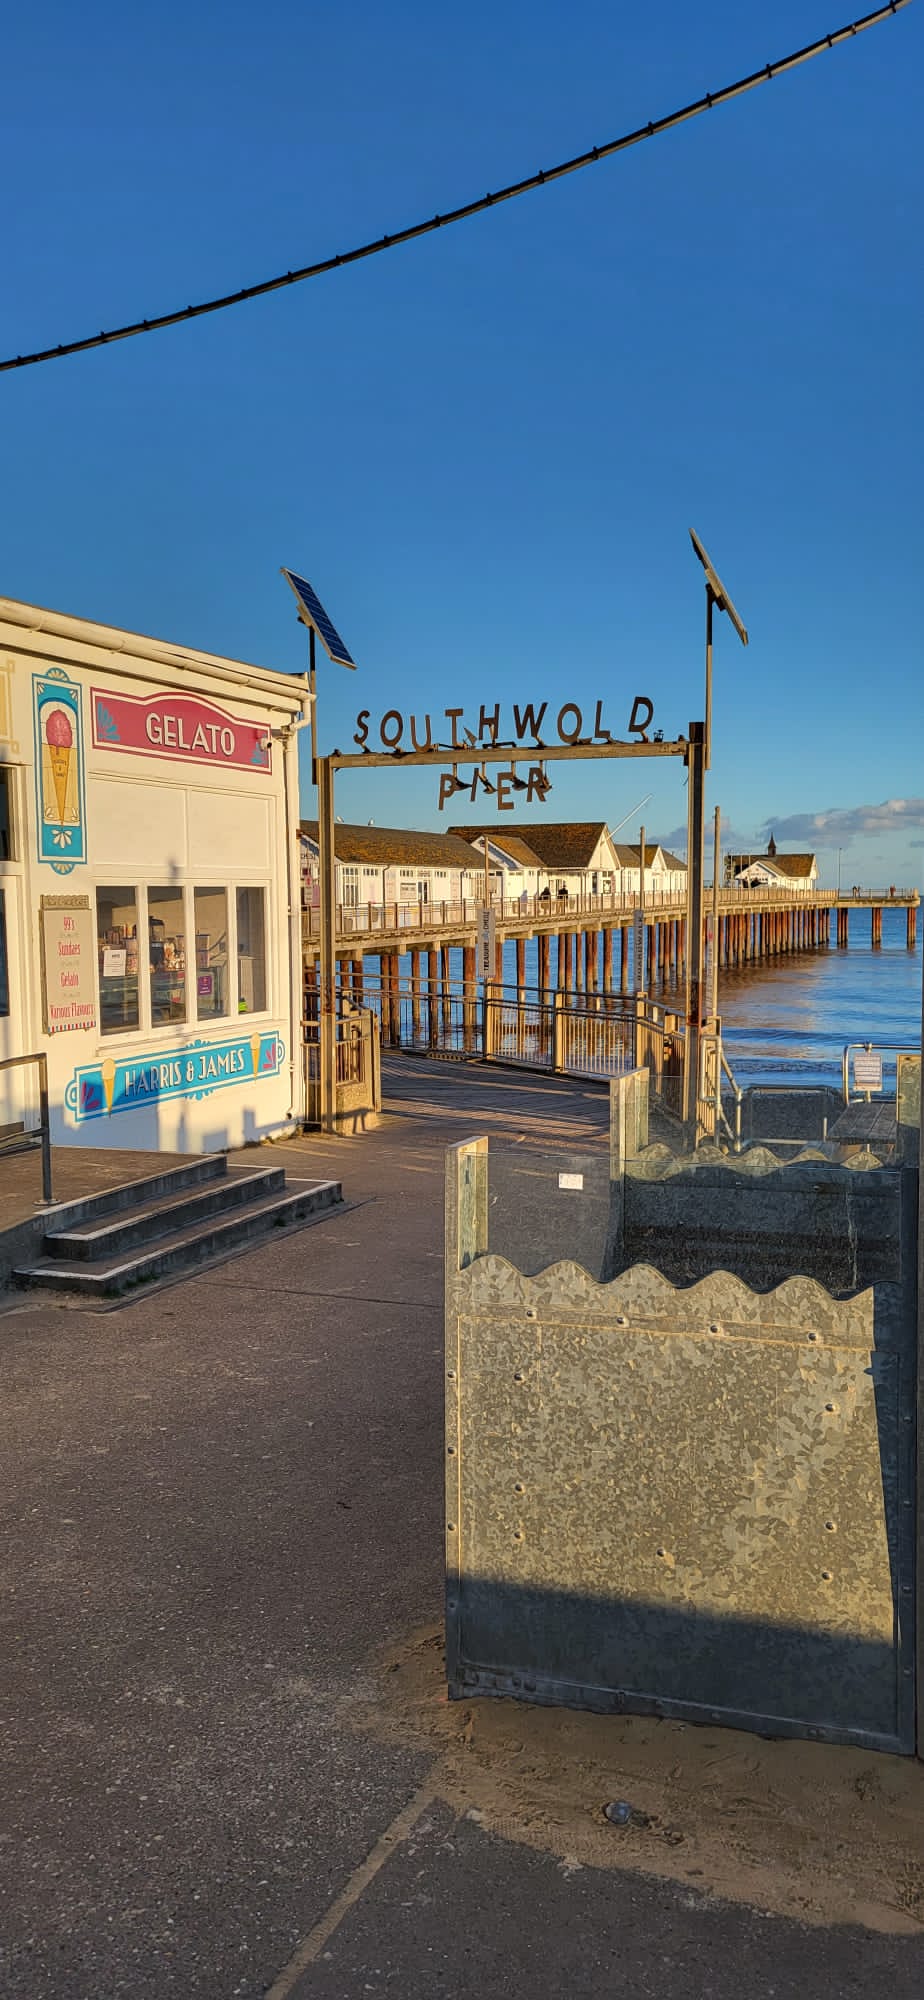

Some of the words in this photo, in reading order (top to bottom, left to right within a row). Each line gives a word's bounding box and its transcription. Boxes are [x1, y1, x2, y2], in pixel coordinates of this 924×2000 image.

[145, 711, 236, 757] GELATO
[353, 696, 654, 753] SOUTHWOLD
[438, 767, 548, 811] PIER
[58, 942, 80, 956] Sundaes
[61, 972, 79, 987] Gelato
[125, 1062, 181, 1096] HARRIS
[186, 1061, 194, 1082] &
[198, 1049, 244, 1080] JAMES
